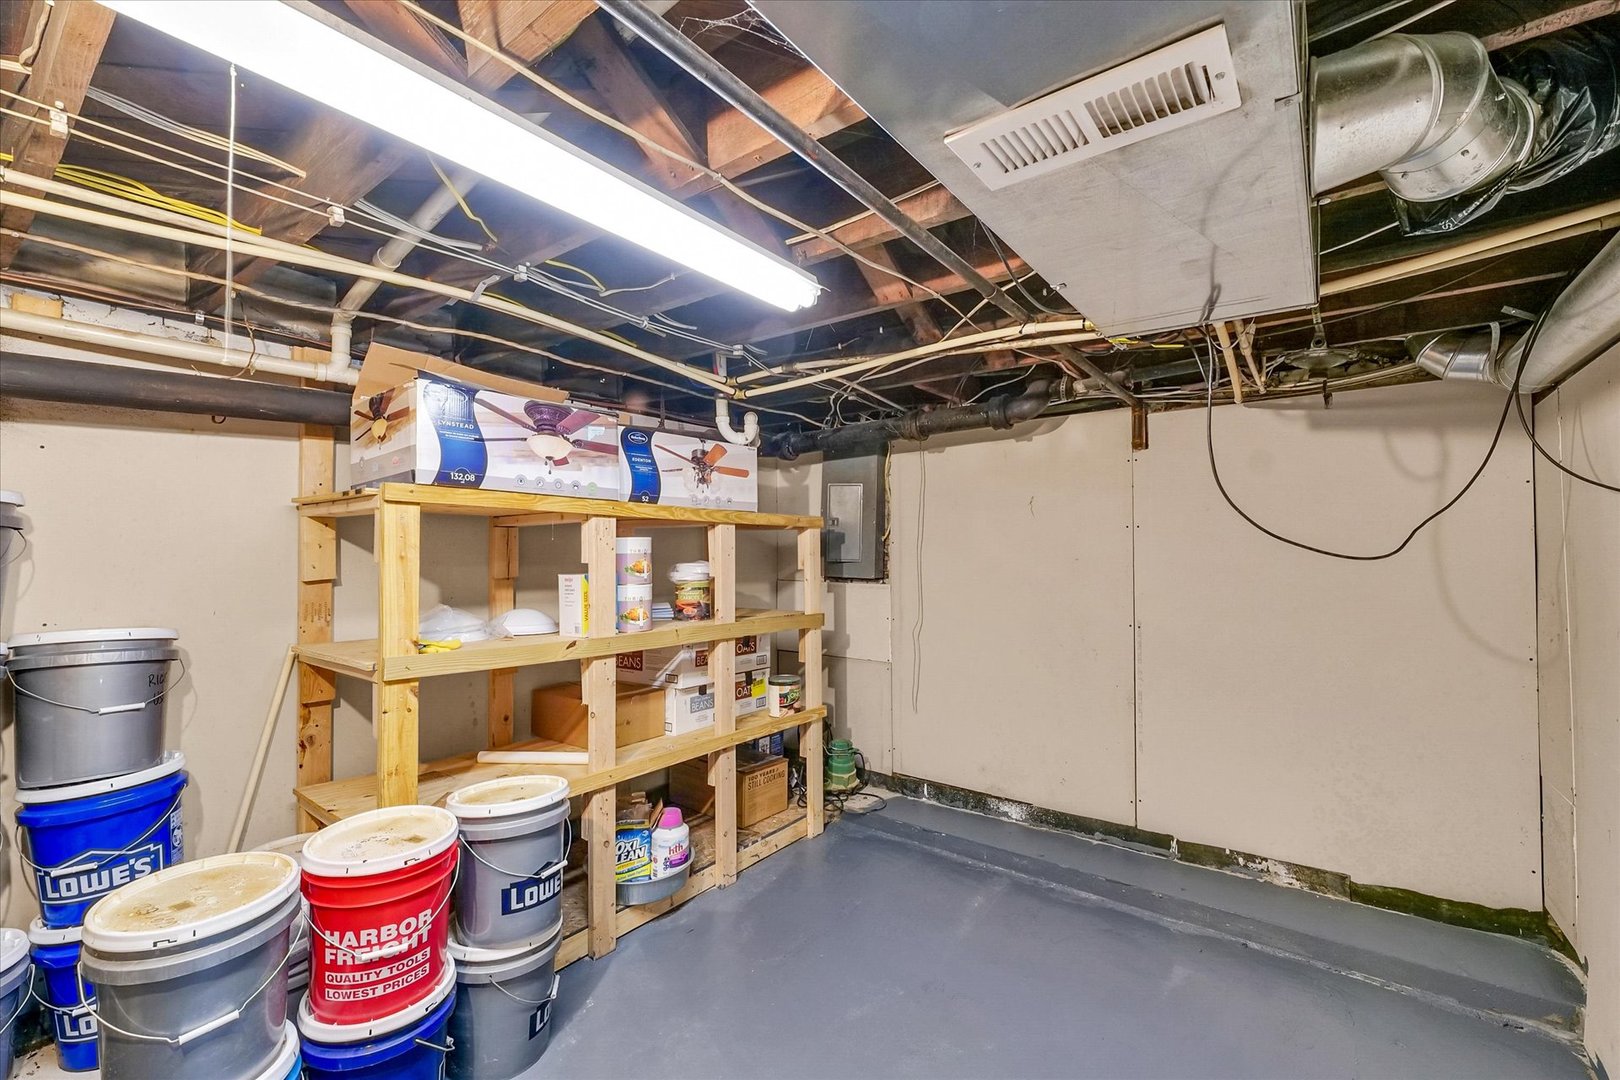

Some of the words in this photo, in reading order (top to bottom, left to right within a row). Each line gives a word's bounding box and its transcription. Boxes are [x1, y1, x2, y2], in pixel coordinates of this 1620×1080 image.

[438, 420, 474, 430] LYNSTEAD
[696, 654, 708, 666] BEA
[148, 674, 164, 688] RIC
[736, 687, 751, 698] OAT
[691, 699, 714, 712] BEANS
[747, 779, 761, 791] STILL
[763, 769, 785, 785] COOKING
[616, 840, 637, 855] OXI
[669, 843, 684, 856] hth
[45, 856, 152, 900] LOWE'S
[511, 880, 561, 909] LOWE
[325, 909, 432, 947] HARBOR
[327, 969, 383, 983] QUALITY
[387, 951, 429, 975] TOOLS
[327, 984, 380, 1000] LOWEST
[383, 966, 428, 991] PRICES
